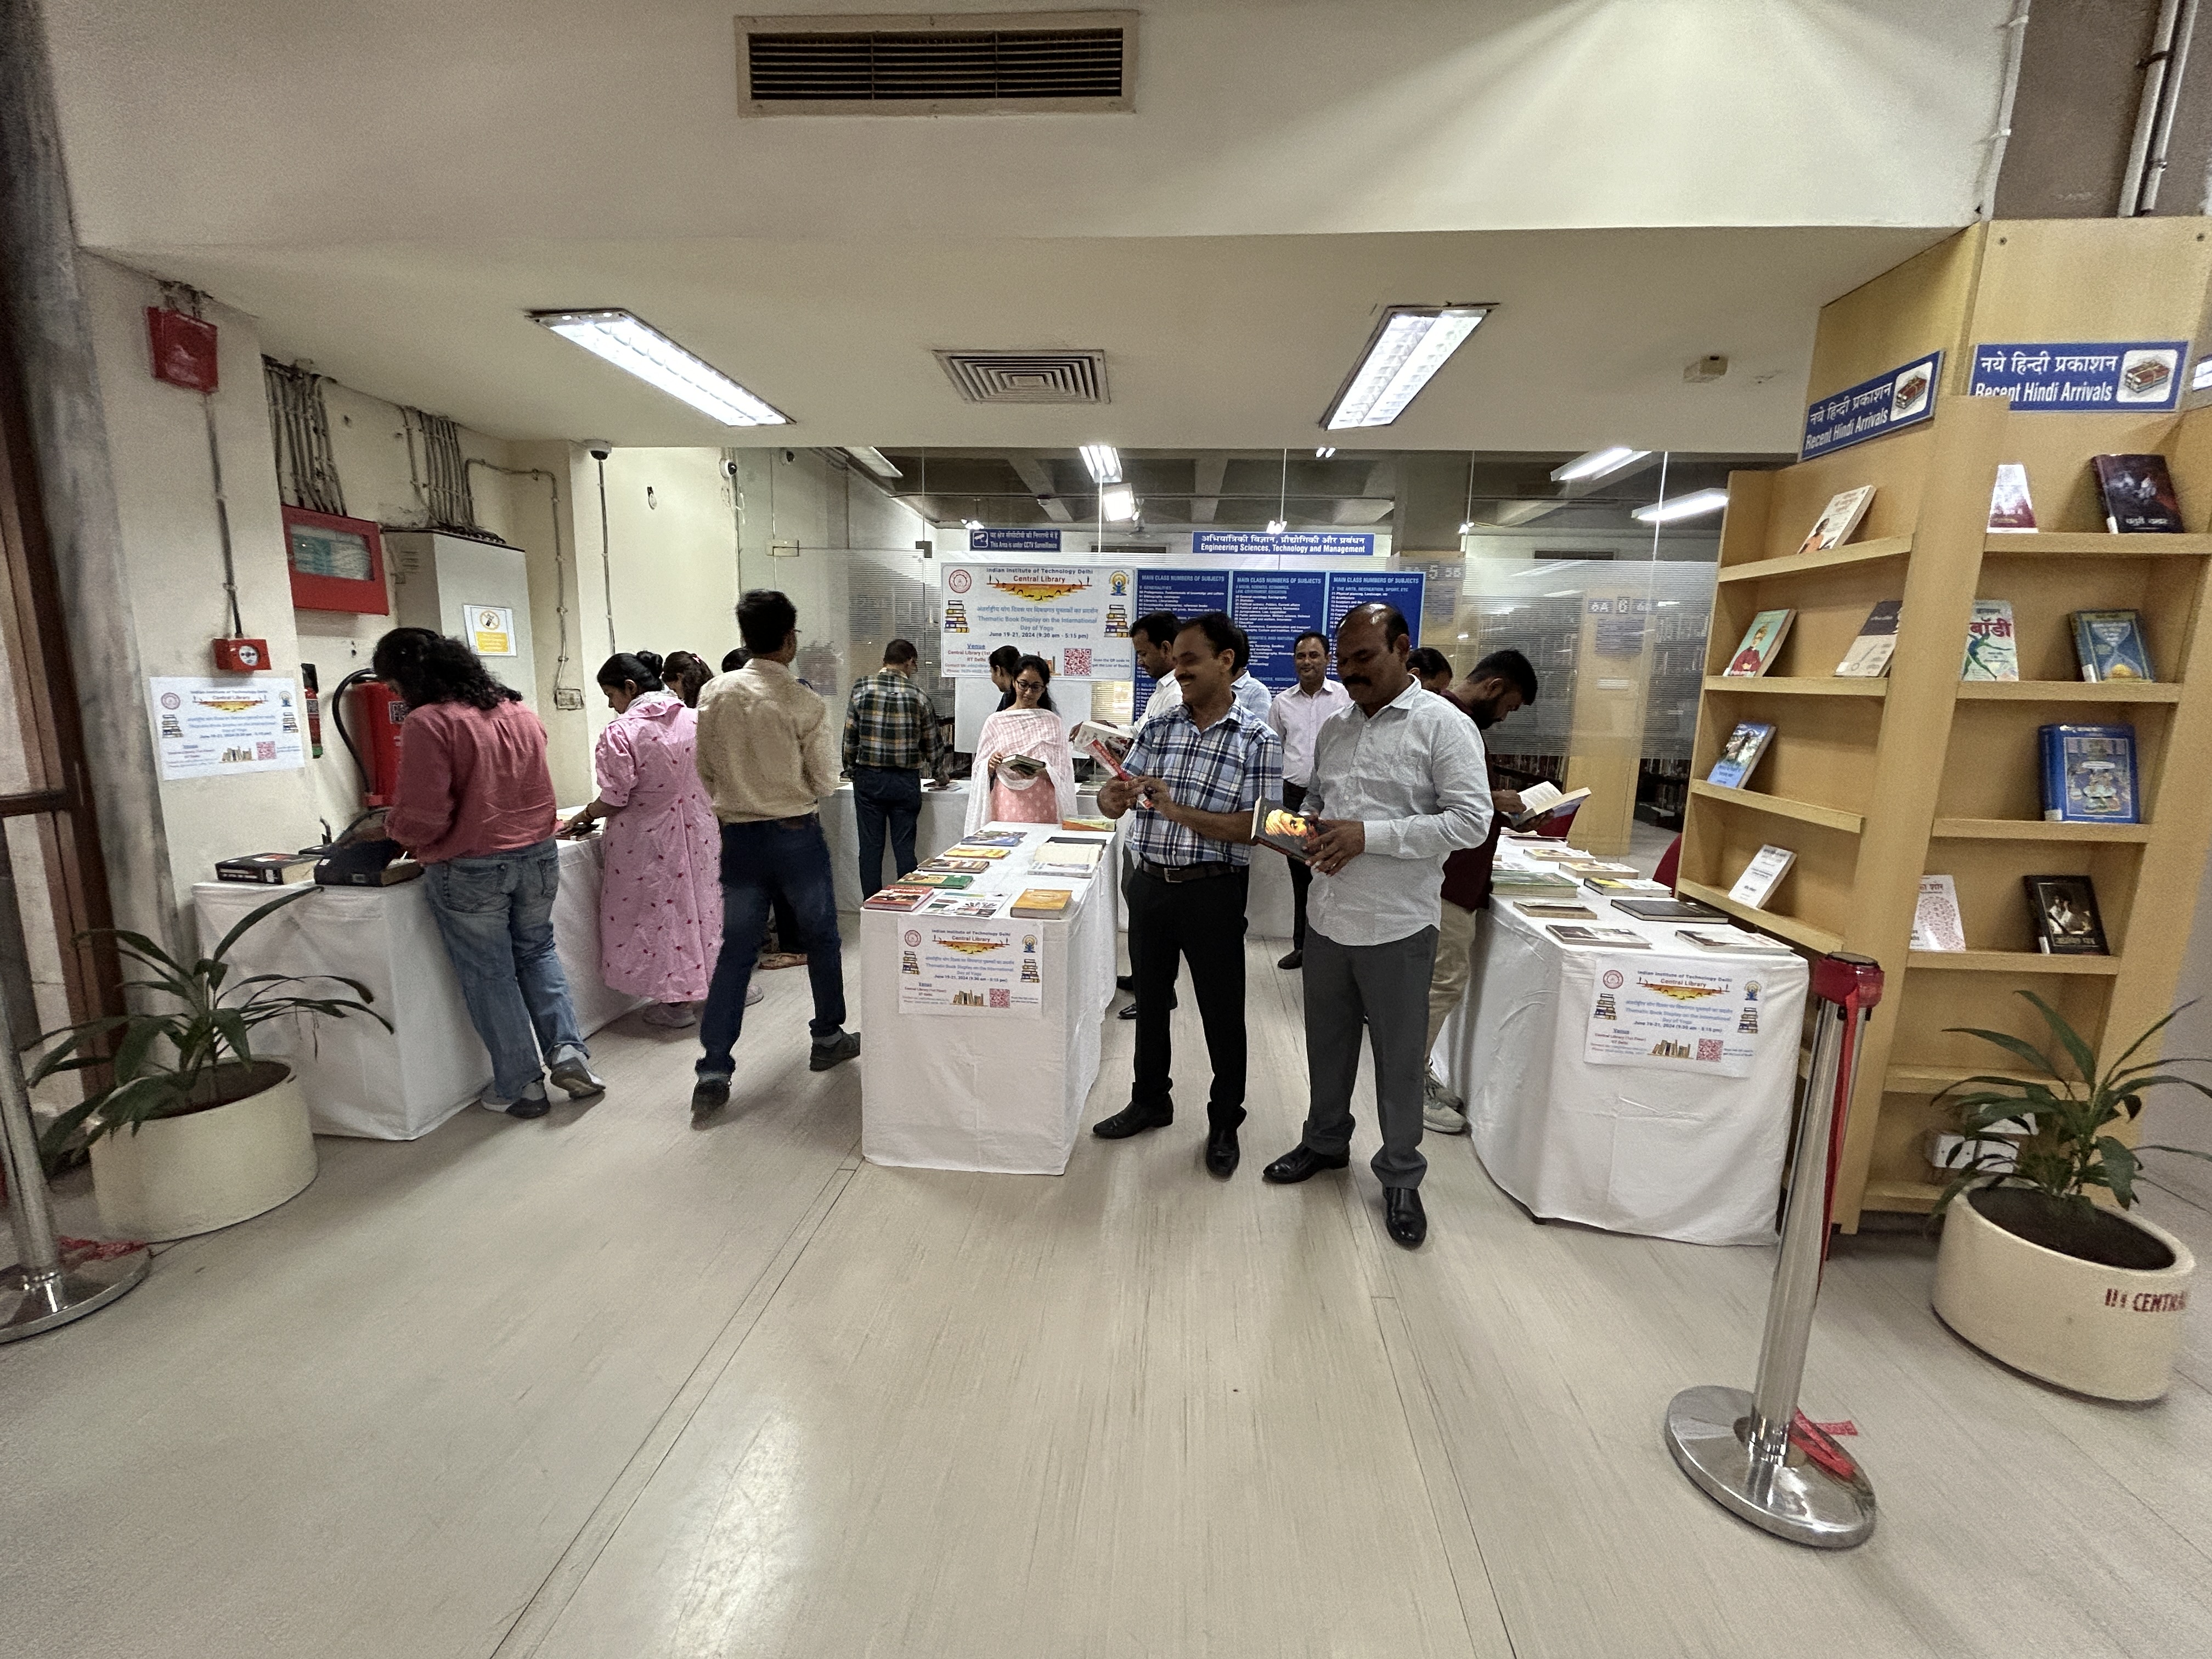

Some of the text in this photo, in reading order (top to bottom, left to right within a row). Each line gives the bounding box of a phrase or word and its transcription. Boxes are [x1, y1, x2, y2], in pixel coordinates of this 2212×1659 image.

[1980, 351, 2118, 375] नये हिन्दी प्रकाशन
[2023, 382, 2059, 402] Hindi
[2060, 381, 2112, 402] Arrivals
[1810, 382, 1893, 425] नये हिन्दी प्रकाशन
[1805, 407, 1888, 450] Recent Hindi Arrivals
[1201, 534, 1248, 543] अभियांत्रिकी
[1322, 535, 1337, 544] और
[1201, 543, 1239, 552] Engineering
[1240, 544, 1271, 552] Sciences,
[1272, 544, 1308, 554] Technology
[1323, 544, 1365, 554] Management
